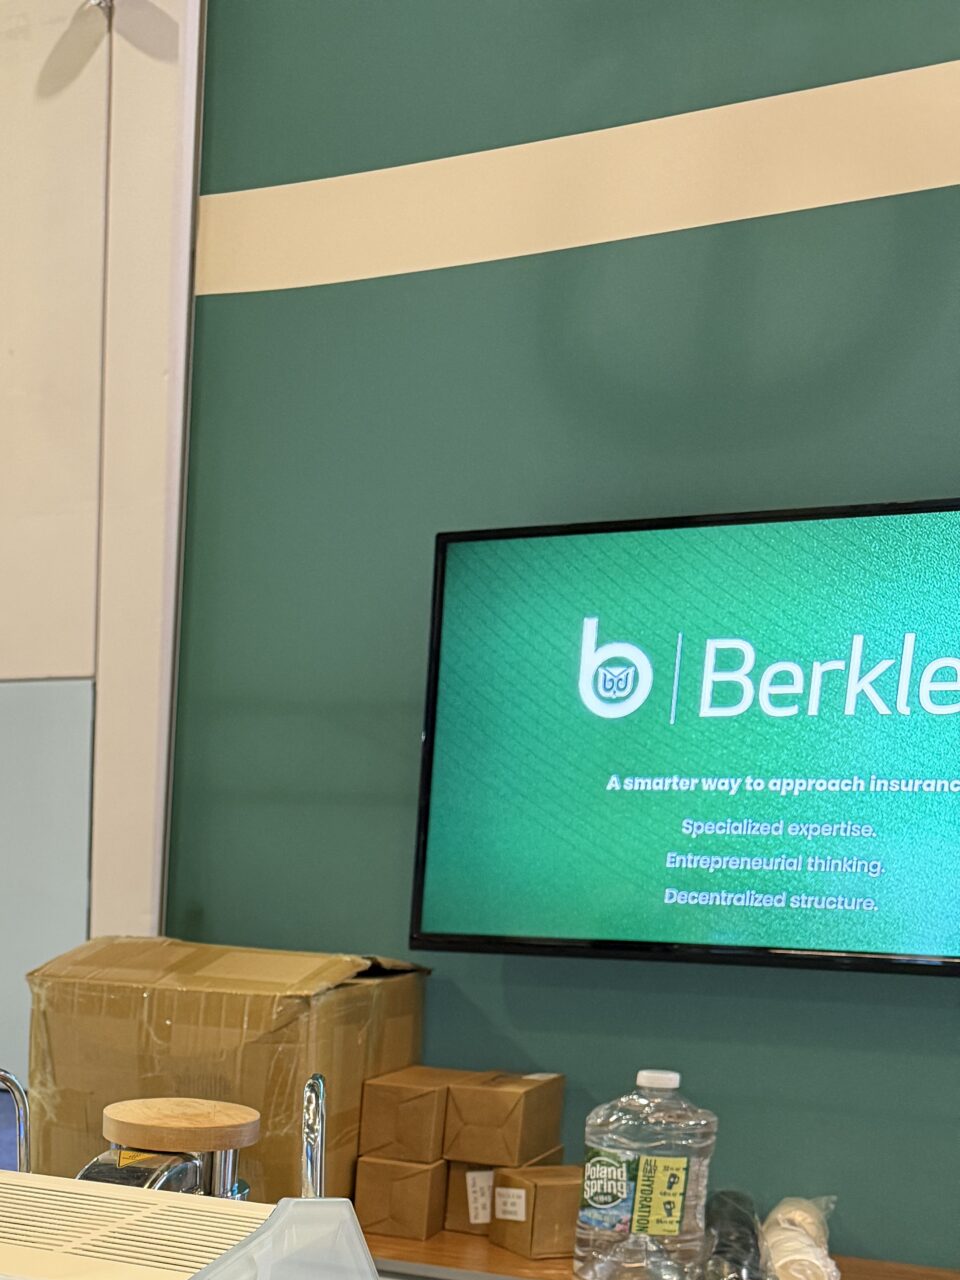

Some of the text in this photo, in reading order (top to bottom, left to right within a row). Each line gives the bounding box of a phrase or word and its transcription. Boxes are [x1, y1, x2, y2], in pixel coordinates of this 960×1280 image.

[698, 632, 960, 718] Berkle
[606, 775, 960, 796] A smarter way to approach insuranc
[681, 818, 877, 841] Specialized expertise.
[665, 852, 886, 877] Entrepreneurial thinking.
[663, 888, 879, 912] Decentralized structure.
[585, 1162, 627, 1181] Poland
